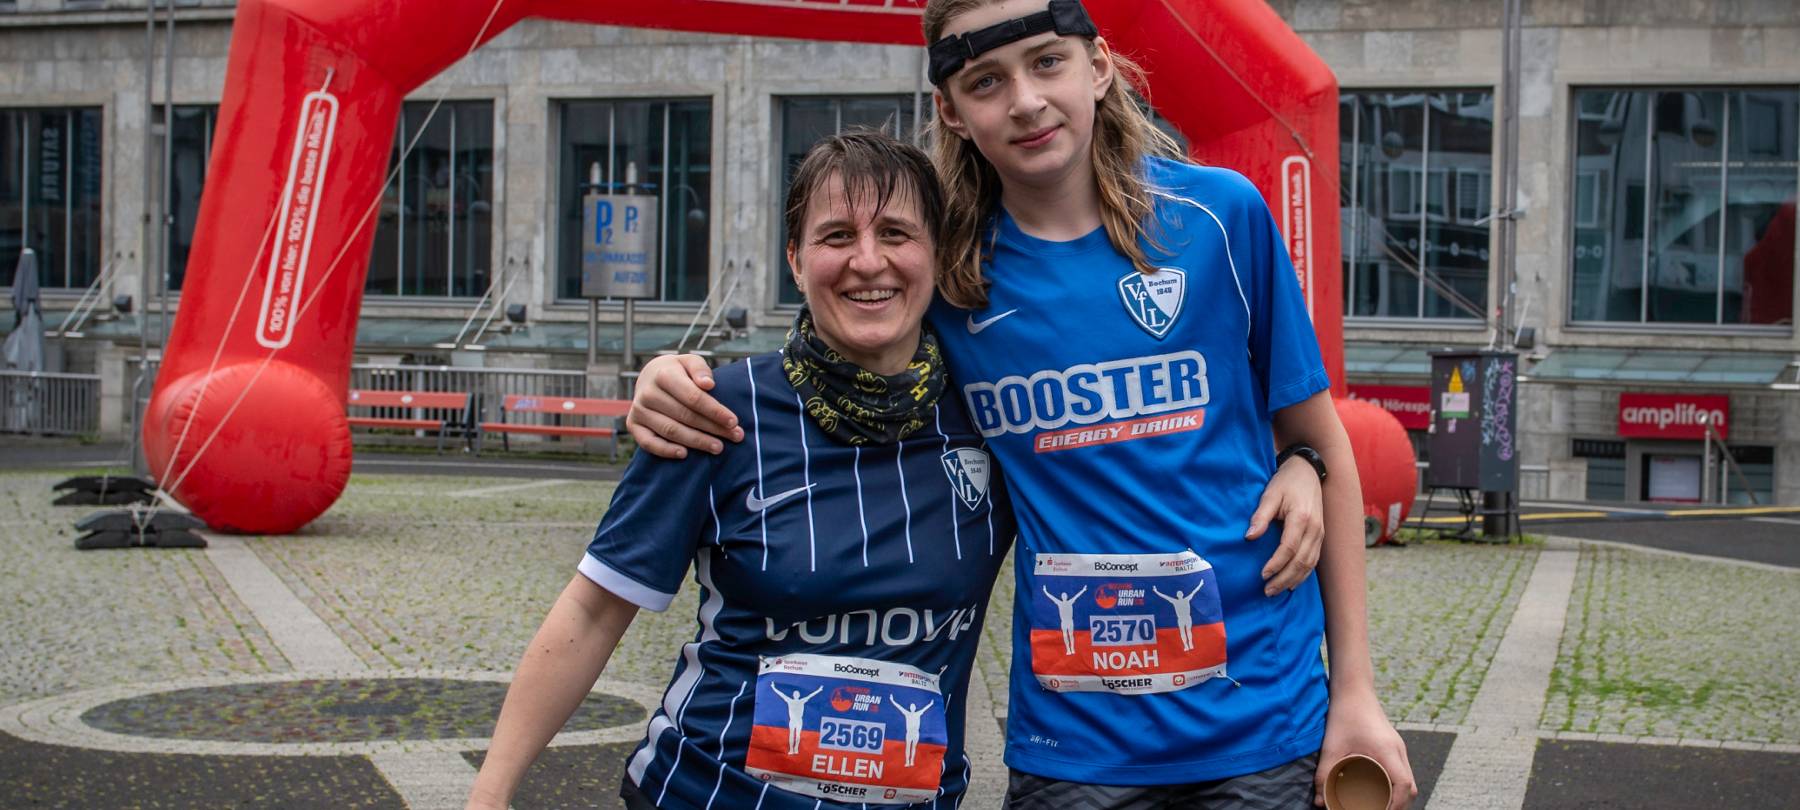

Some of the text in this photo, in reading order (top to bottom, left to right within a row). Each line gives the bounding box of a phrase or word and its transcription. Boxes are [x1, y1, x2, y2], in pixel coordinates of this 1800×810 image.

[300, 149, 318, 184] beste
[297, 185, 311, 205] die
[288, 205, 306, 242] 100%
[1293, 207, 1304, 240] beste
[1294, 240, 1304, 258] die
[281, 271, 293, 294] von
[1148, 279, 1178, 287] Bochum
[269, 295, 288, 333] 100%
[969, 357, 1203, 431] BOOSTER
[1622, 403, 1724, 429] amplifon
[1038, 414, 1198, 450] ENERGY DRINK
[1094, 562, 1138, 573] BoConcept
[1117, 598, 1134, 606] RUN
[1118, 589, 1144, 598] URBAN
[1092, 619, 1155, 642] 2570
[1093, 650, 1159, 670] NOAH
[834, 664, 879, 677] BoConcept
[1102, 676, 1153, 690] LÖSCHER
[852, 702, 870, 711] RUN
[854, 694, 881, 705] URBAN
[821, 722, 883, 750] 2569
[811, 754, 884, 779] ELLEN
[817, 782, 867, 797] LÖSCHER
